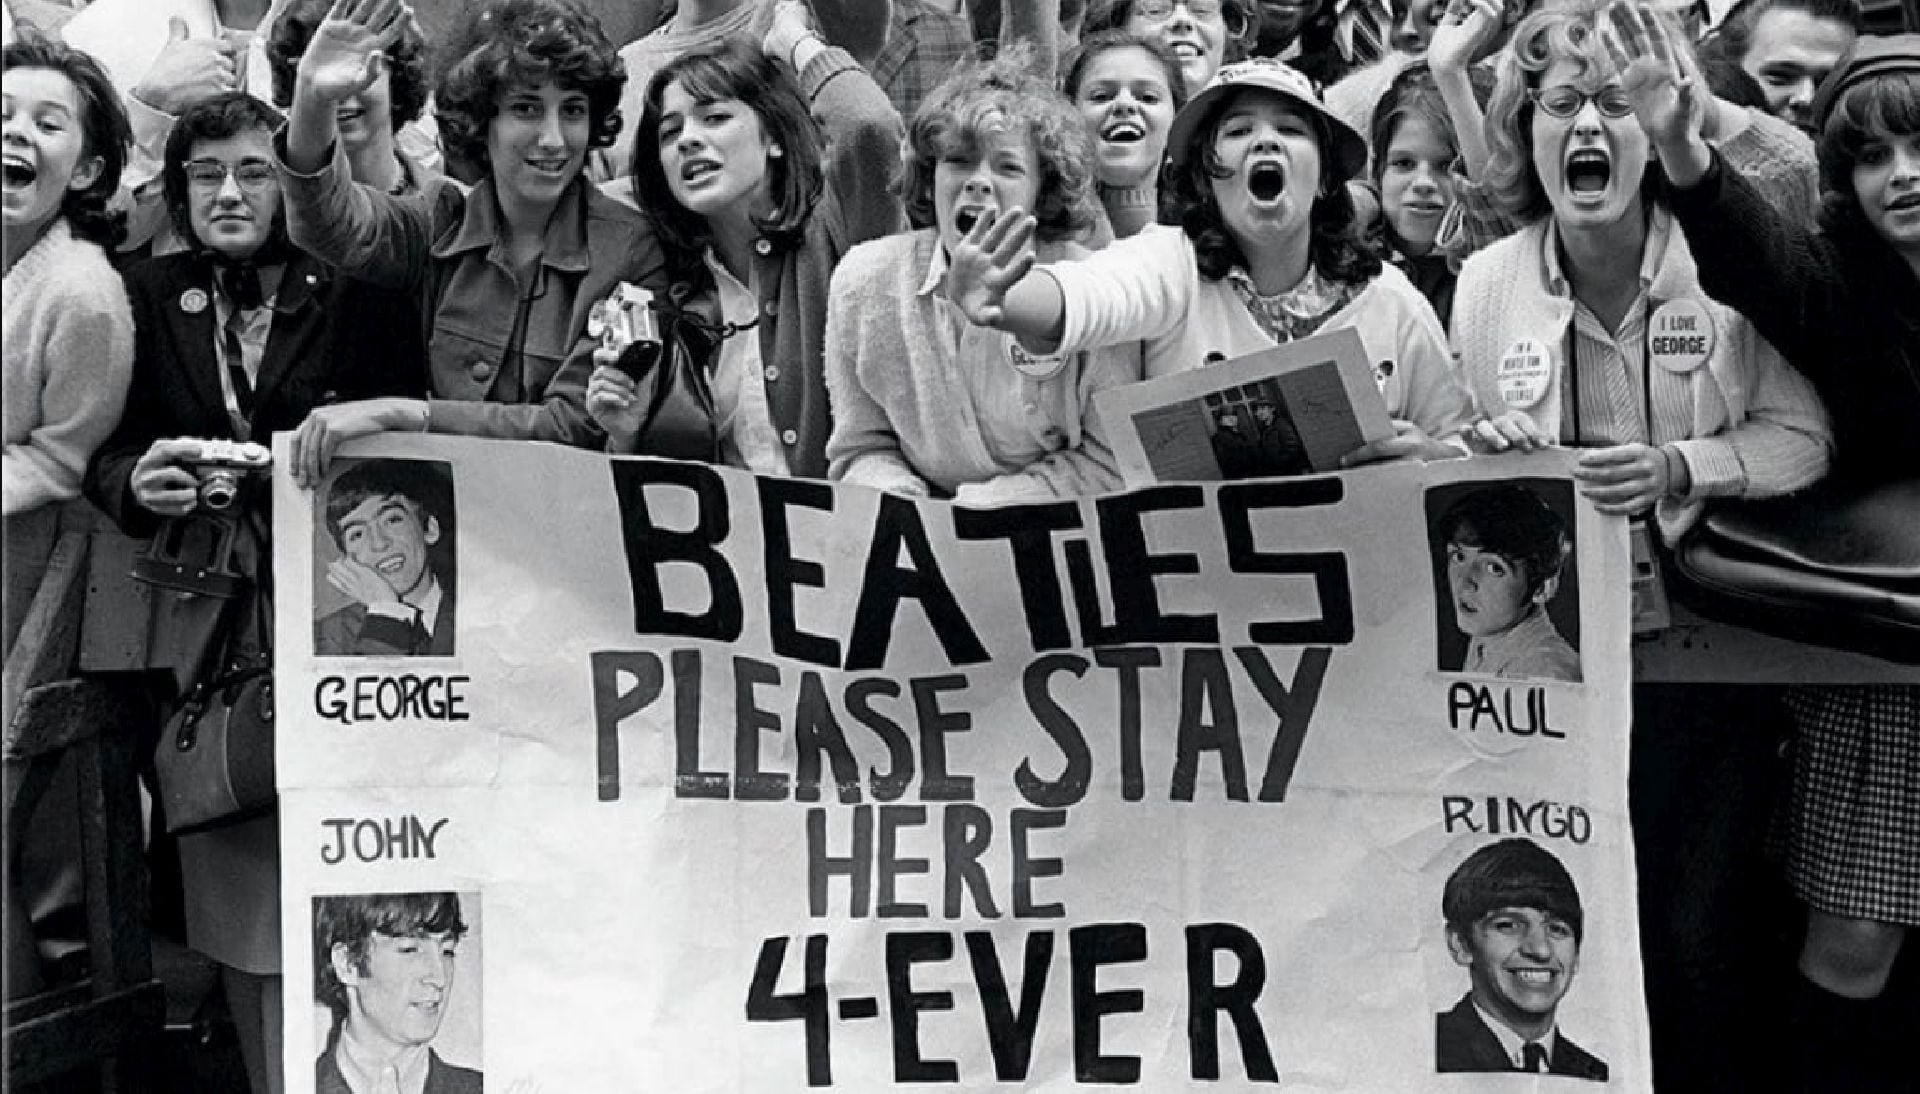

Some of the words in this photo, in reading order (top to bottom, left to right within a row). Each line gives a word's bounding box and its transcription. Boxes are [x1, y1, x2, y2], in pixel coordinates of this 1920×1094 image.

[1653, 335, 1705, 355] GEORGE
[1661, 315, 1666, 331] I
[1669, 315, 1697, 331] LOVE
[610, 460, 1354, 671] BEATLES
[315, 673, 471, 725] GEORGE
[1449, 682, 1566, 739] PAUL
[590, 648, 976, 804] PLEASE
[1014, 647, 1333, 807] STAY
[320, 813, 450, 866] JOHN
[1442, 796, 1591, 844] RINGO
[806, 805, 1067, 919] HERE
